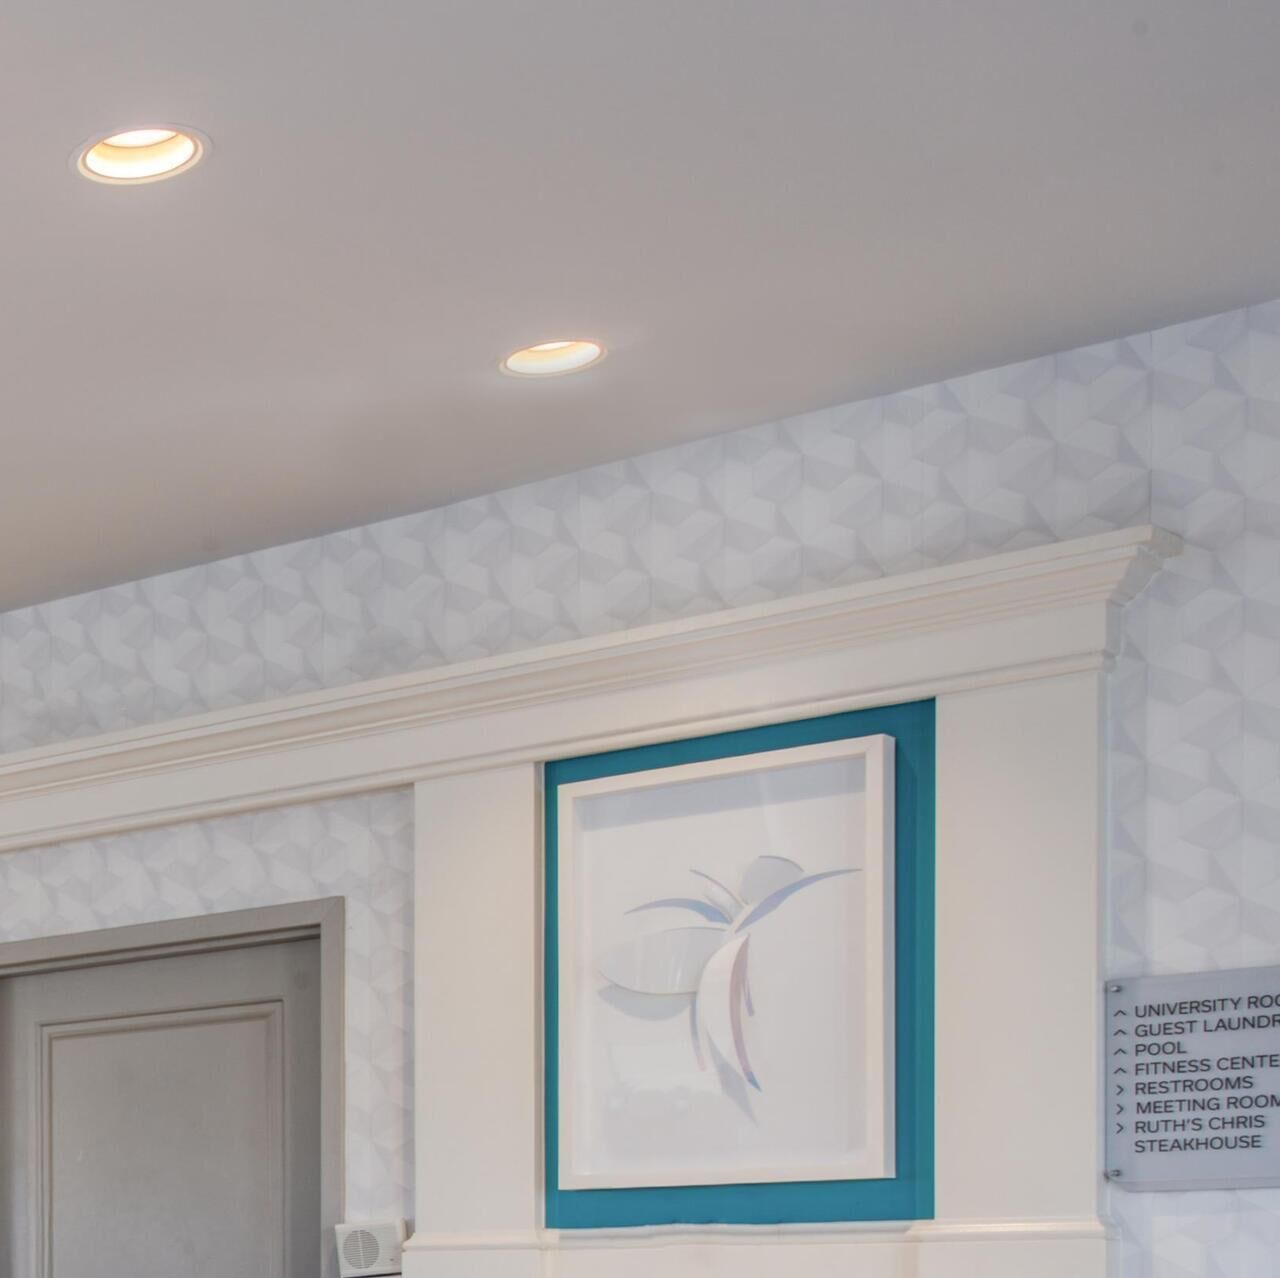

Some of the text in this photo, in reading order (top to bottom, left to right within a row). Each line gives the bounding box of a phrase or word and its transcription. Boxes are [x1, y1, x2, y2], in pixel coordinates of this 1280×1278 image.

[1135, 997, 1241, 1018] UNIVERSITY
[1134, 1020, 1198, 1037] GUEST
[1135, 1041, 1187, 1056] POOL
[1135, 1058, 1211, 1075] FITNESS
[1135, 1075, 1254, 1095] RESTROOMS
[1136, 1097, 1220, 1115] MEETING
[1135, 1115, 1265, 1134] RUTH'S CHRIS
[1134, 1134, 1262, 1153] STEAKHOUSE
